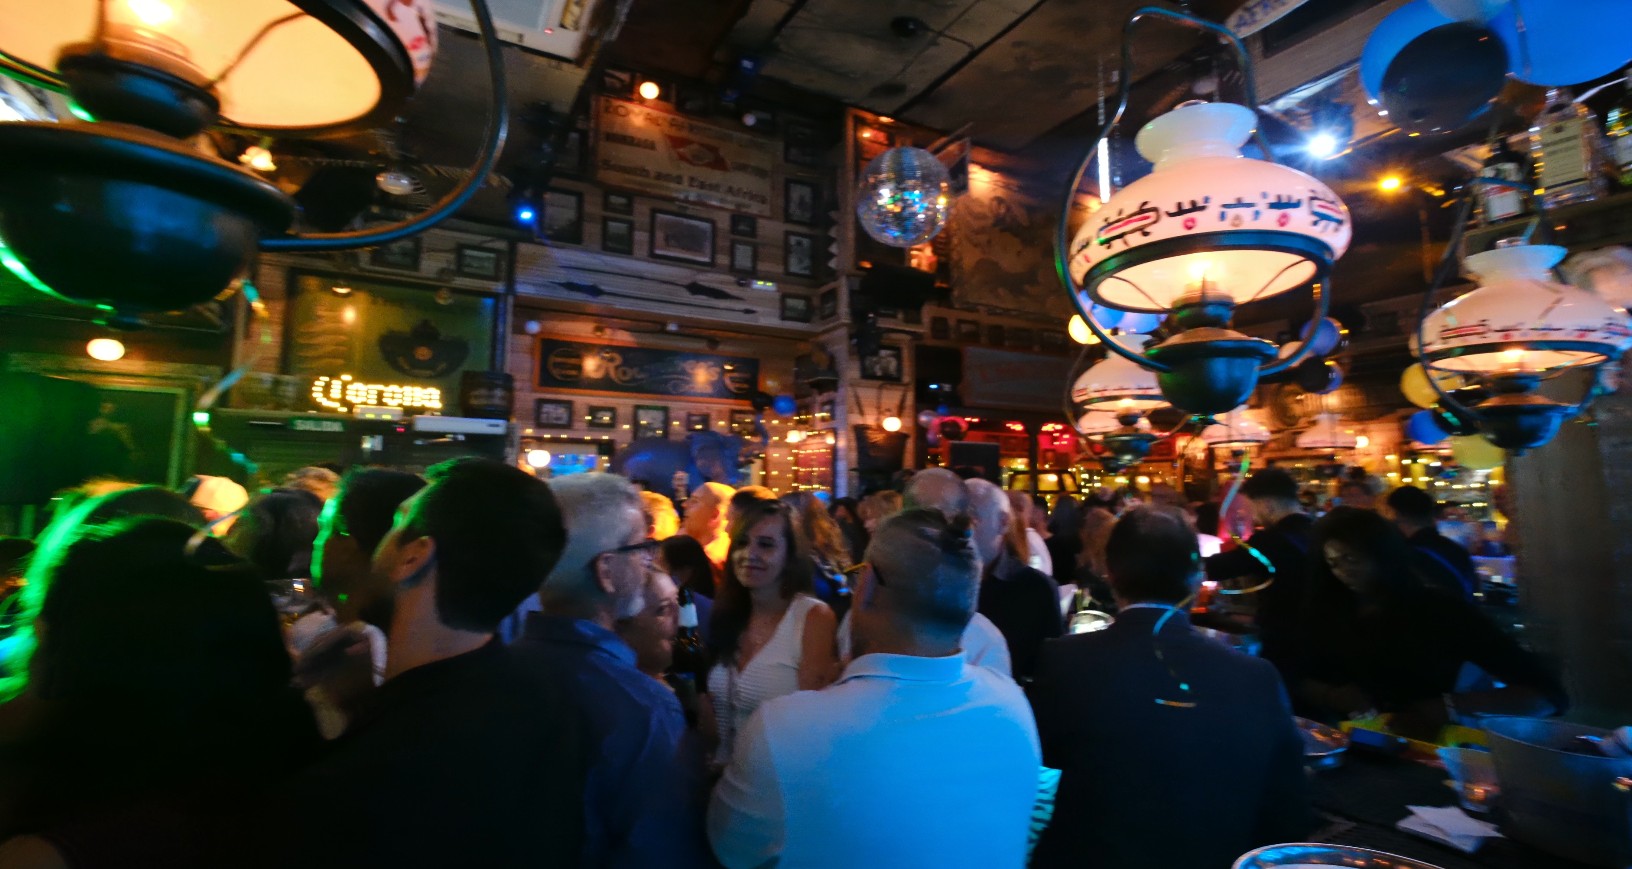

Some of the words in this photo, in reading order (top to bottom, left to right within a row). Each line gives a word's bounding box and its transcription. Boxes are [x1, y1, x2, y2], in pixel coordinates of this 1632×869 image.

[601, 158, 650, 178] South
[654, 171, 684, 185] and
[689, 176, 722, 193] East
[726, 185, 768, 205] Africa
[311, 374, 443, 412] Corona
